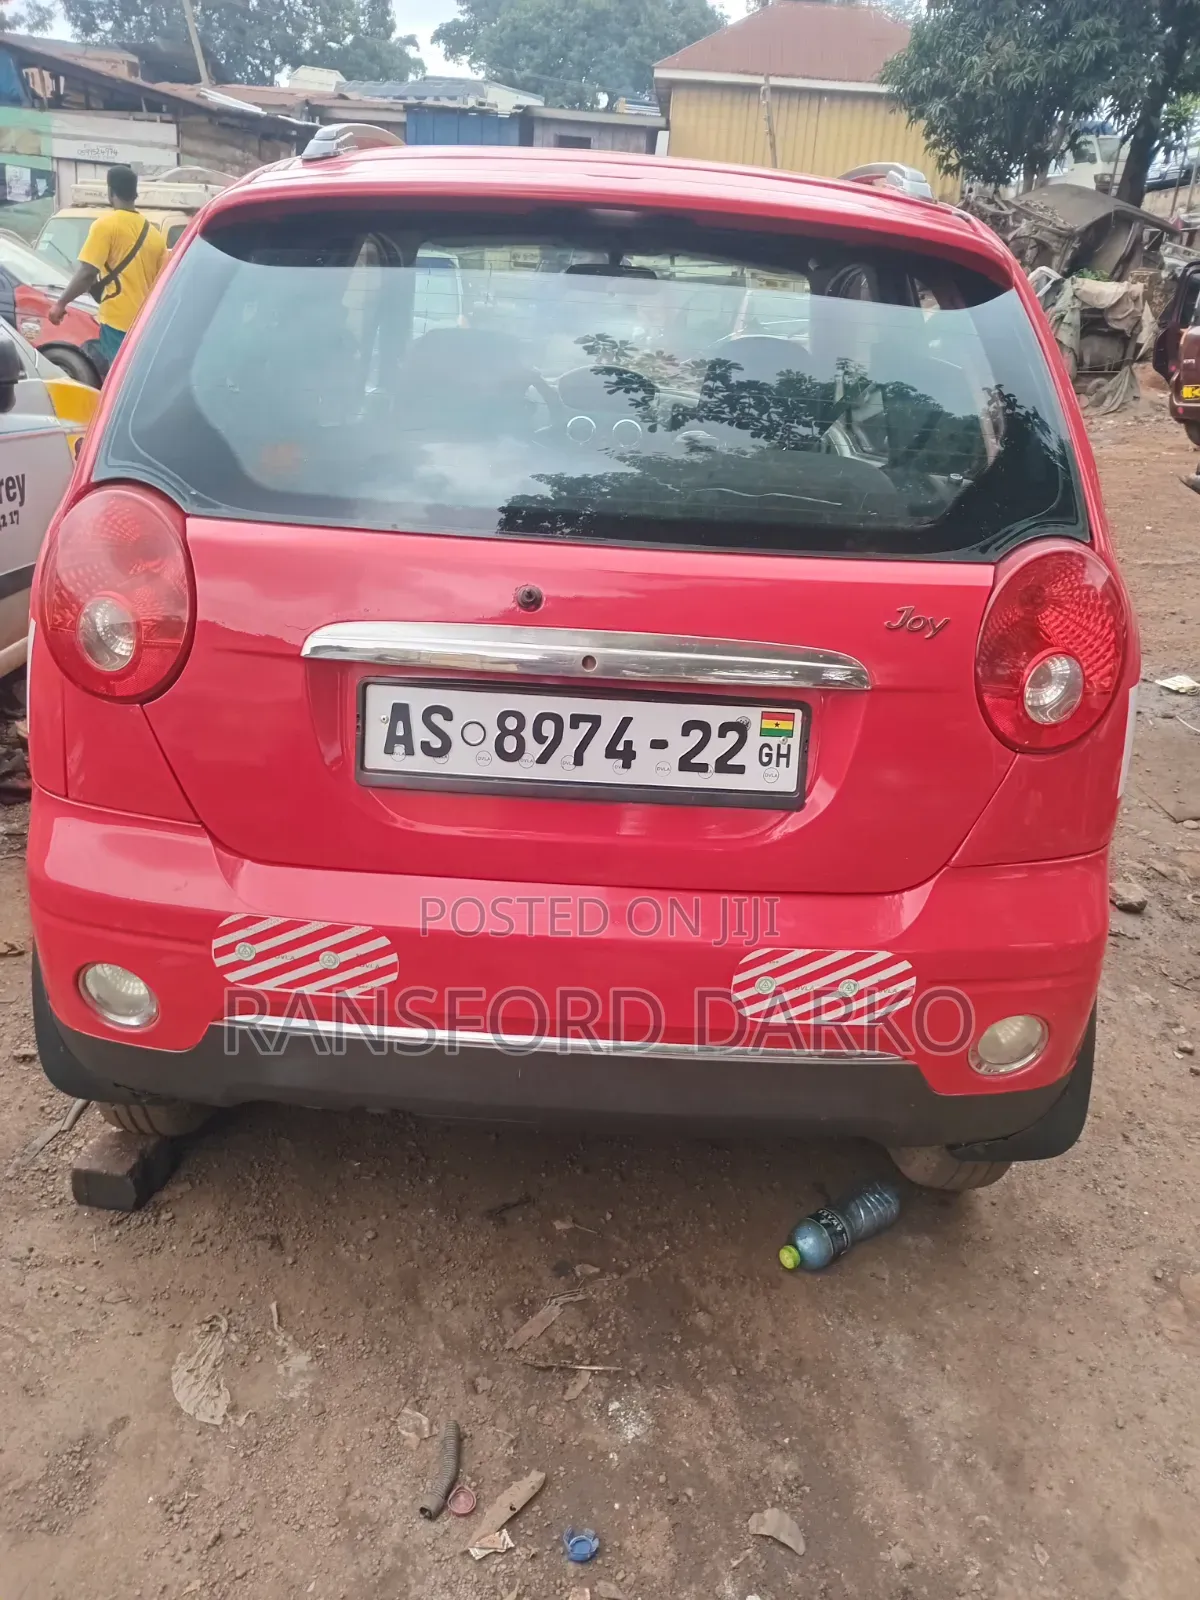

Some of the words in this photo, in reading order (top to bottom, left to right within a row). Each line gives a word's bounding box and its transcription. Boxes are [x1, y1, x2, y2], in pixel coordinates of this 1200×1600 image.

[884, 605, 951, 640] Joy
[383, 702, 454, 759] AS
[494, 709, 748, 775] 8974-22
[758, 742, 791, 769] GH
